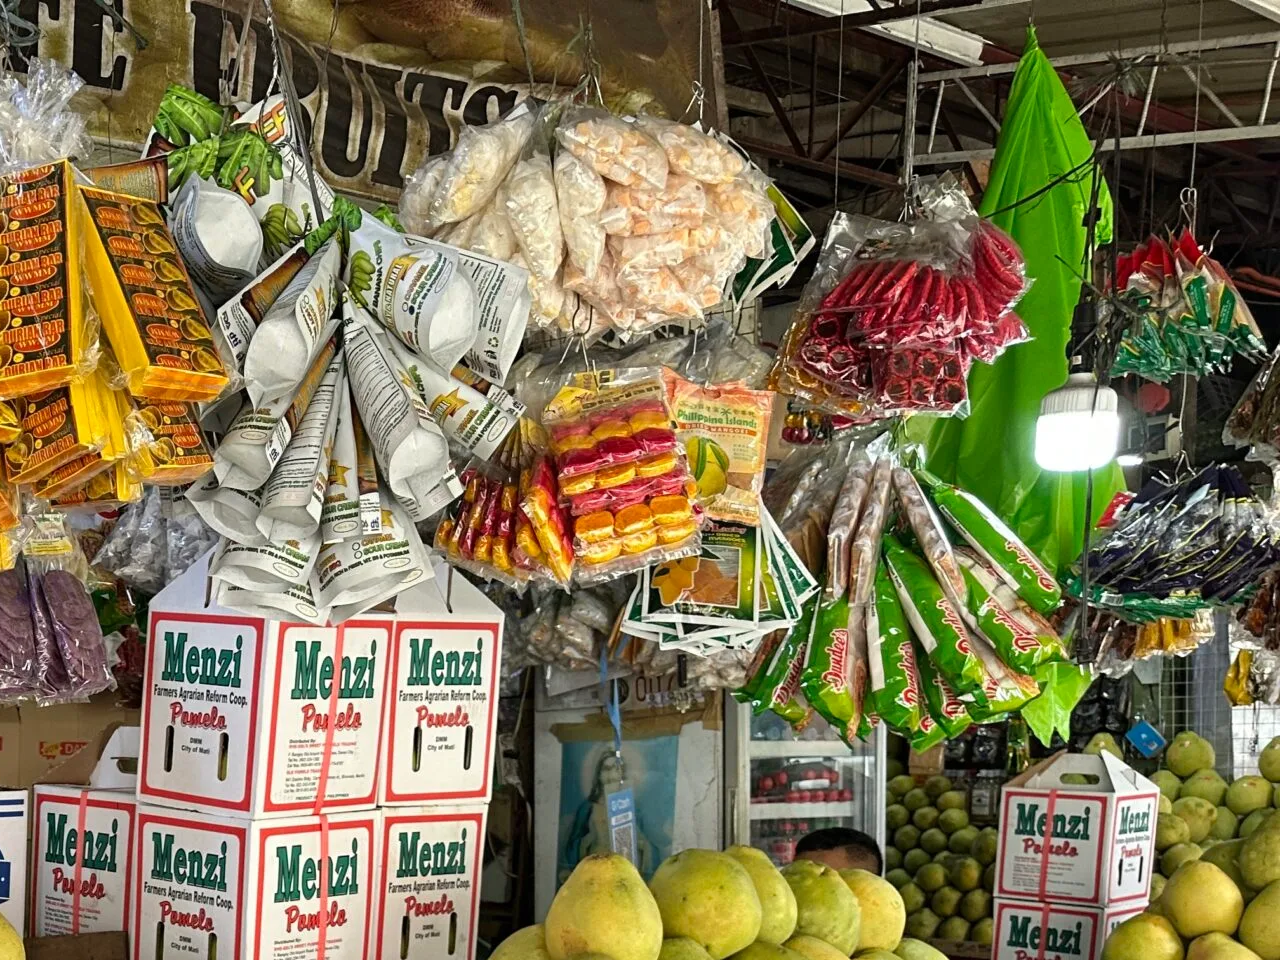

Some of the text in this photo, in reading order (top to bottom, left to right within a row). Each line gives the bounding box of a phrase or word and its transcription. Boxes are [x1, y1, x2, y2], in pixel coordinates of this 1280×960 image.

[39, 184, 60, 200] BAR
[14, 199, 53, 216] WWMM
[1, 220, 63, 244] DURIAN BAR
[1, 252, 63, 277] DURIAN BAR
[15, 267, 53, 282] WWMM
[372, 267, 384, 308] BANANA
[384, 263, 404, 299] NATURAL
[2, 287, 64, 311] DURIAN BAR
[3, 319, 65, 345] DURIAN BAR
[44, 354, 67, 368] BAR
[677, 408, 724, 424] Philippine
[161, 630, 243, 688] Menzi
[291, 638, 377, 700] Menzi
[407, 637, 483, 686] Menzi
[823, 628, 849, 694] Dundee's
[153, 684, 248, 708] Farmers Agrarian Reform Coop.
[399, 690, 488, 704] Farmers Agrarian Reform Coop.
[170, 702, 227, 732] Pomelo
[415, 705, 470, 729] Pomelo
[1014, 803, 1091, 840] Menzi
[1118, 803, 1151, 835] Menzi
[45, 811, 118, 873] Menzi
[396, 828, 468, 879] Menzi
[151, 832, 228, 892] Menzi
[274, 837, 359, 904] Menzi
[143, 881, 234, 912] Farmers Agrarian Reform Coop.
[388, 879, 471, 895] Farmers Agrarian Reform Coop.
[159, 901, 215, 933] Pomelo
[404, 893, 455, 918] Pomelo
[1006, 915, 1082, 955] Menzi
